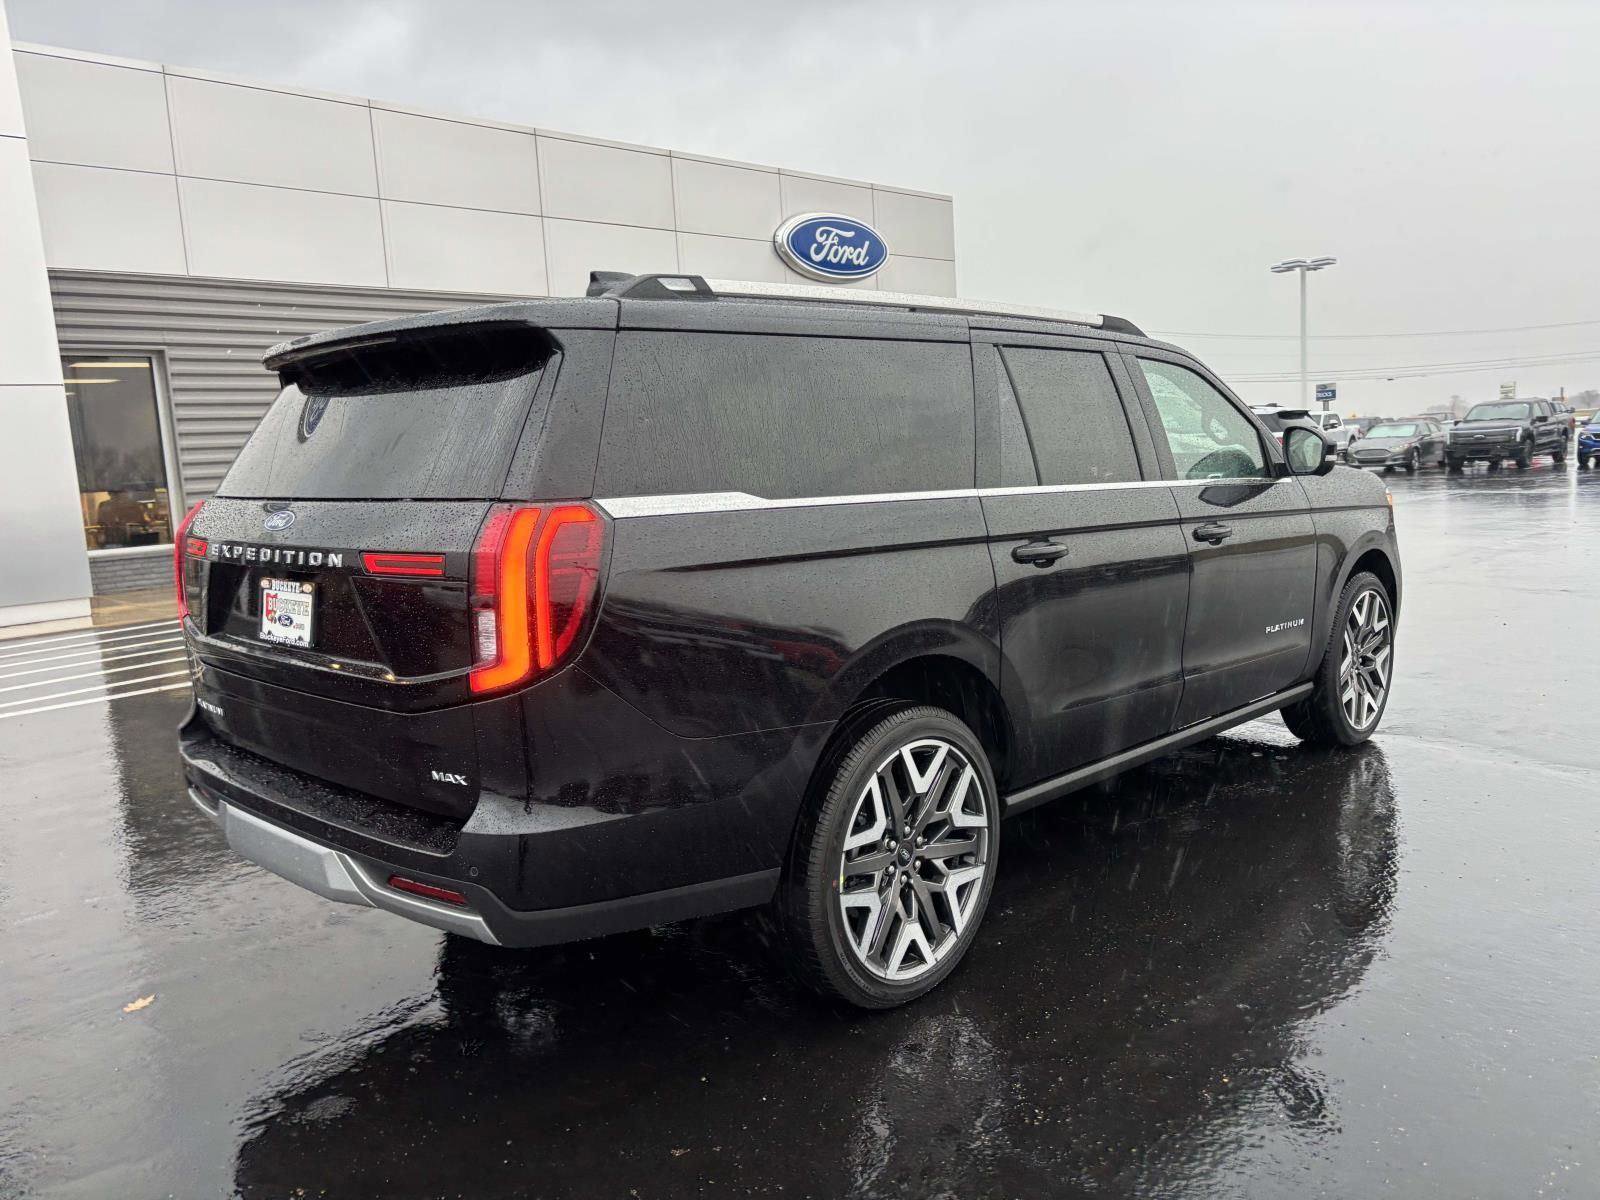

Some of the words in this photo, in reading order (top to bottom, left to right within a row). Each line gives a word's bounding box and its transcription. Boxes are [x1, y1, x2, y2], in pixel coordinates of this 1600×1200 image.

[810, 226, 870, 266] Ford
[211, 544, 343, 568] EXPEDITION
[269, 598, 310, 616] BUCKEYE
[1265, 618, 1305, 634] PLATINUM
[432, 770, 468, 786] MAX
